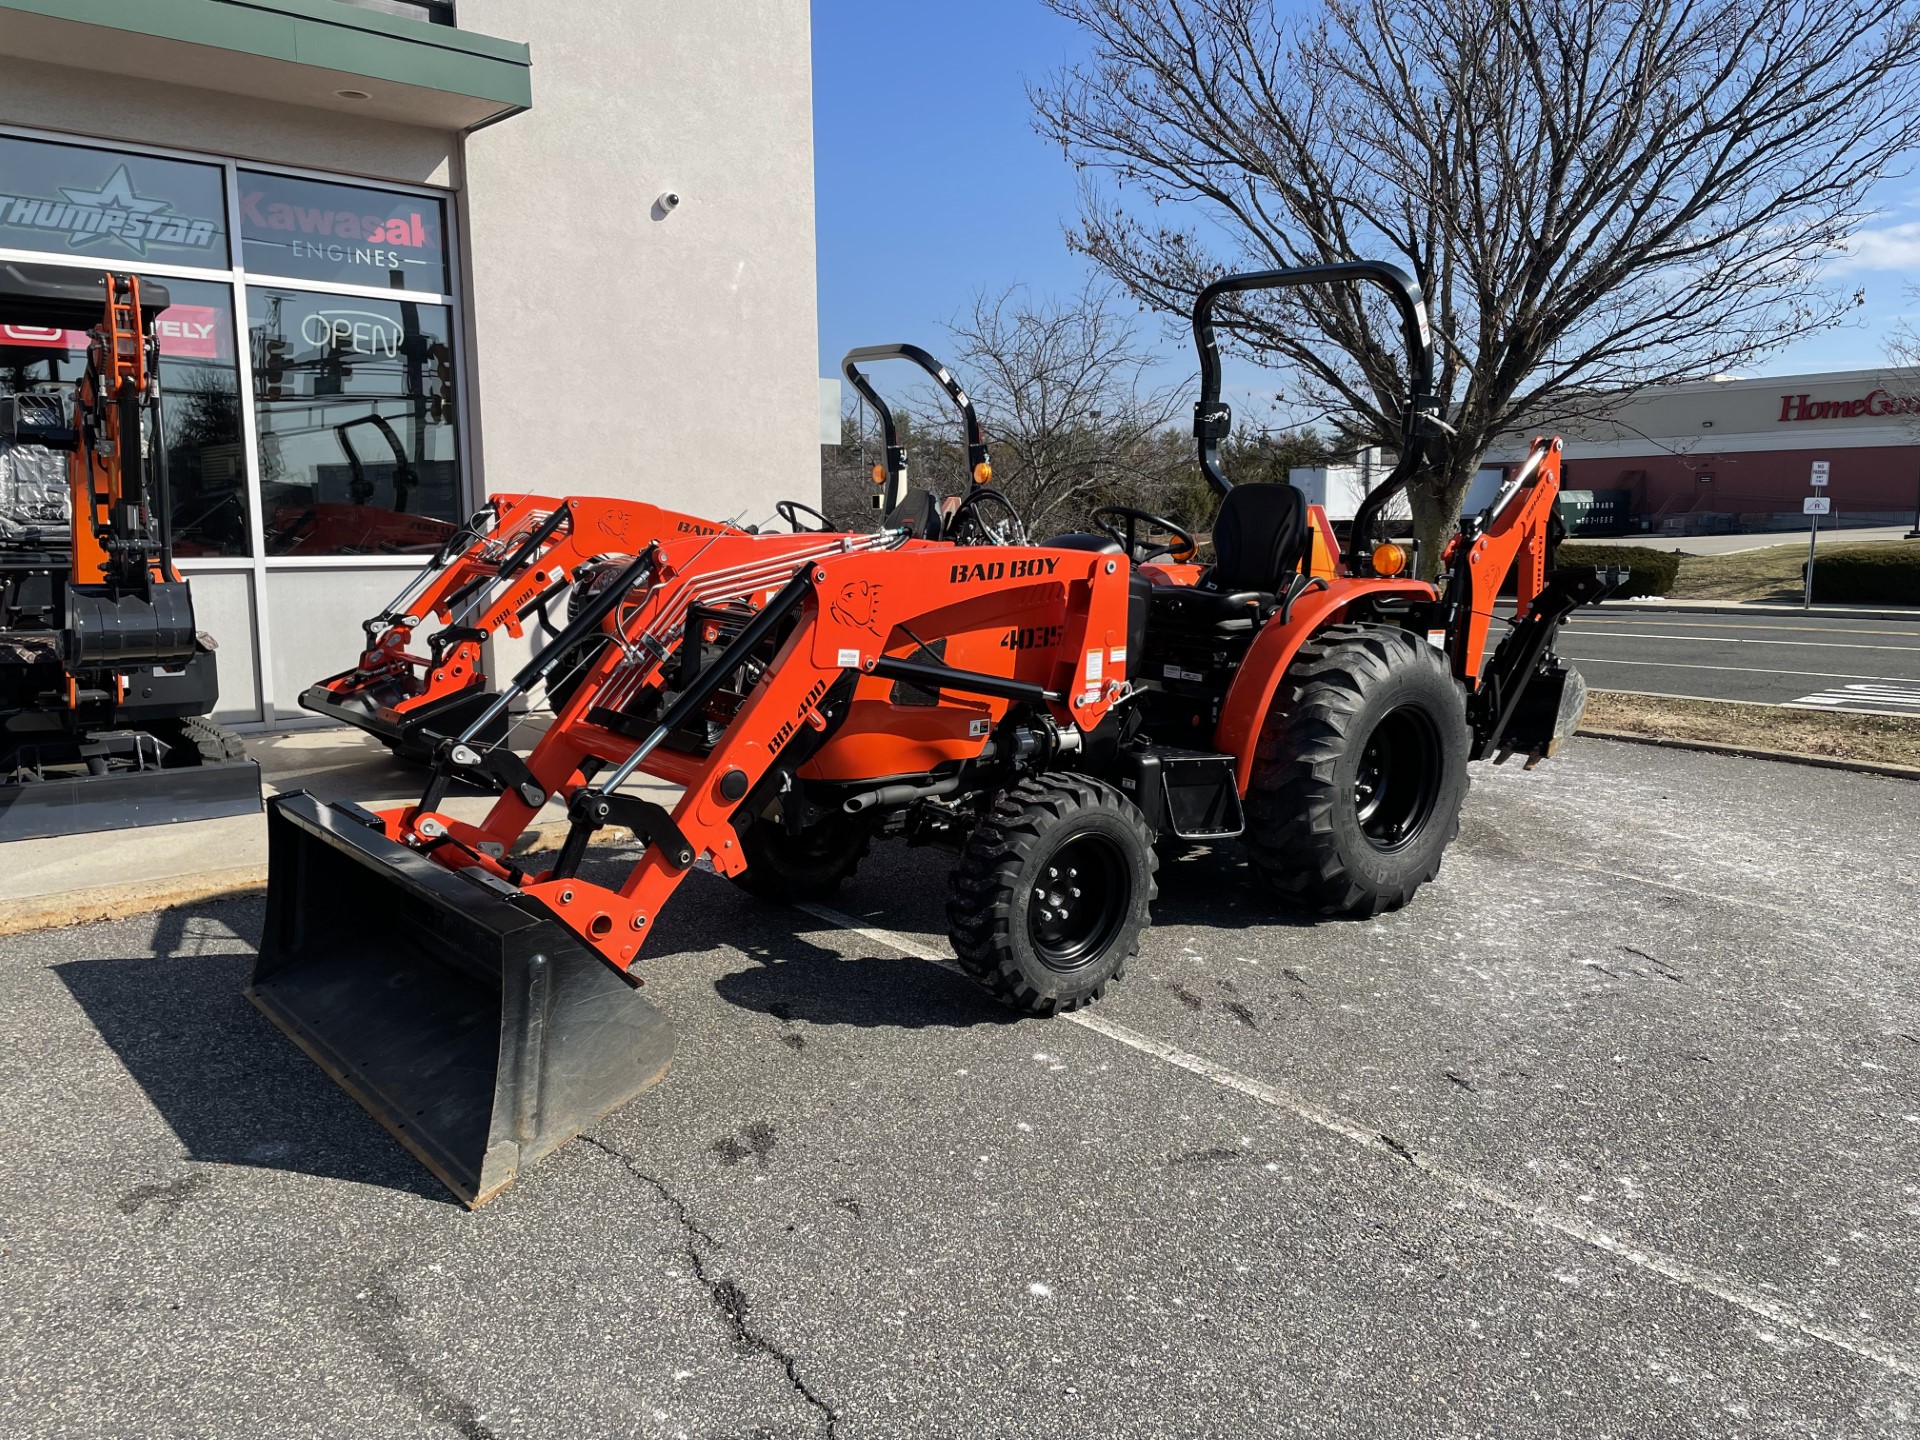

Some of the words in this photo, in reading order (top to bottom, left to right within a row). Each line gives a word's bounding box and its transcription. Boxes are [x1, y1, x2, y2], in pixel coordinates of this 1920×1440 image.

[292, 240, 399, 269] ENGINES
[301, 313, 399, 359] OPEN
[949, 562, 1005, 584] BAD
[1009, 556, 1061, 578] BOY
[1000, 625, 1064, 651] 4035
[796, 678, 827, 720] 400
